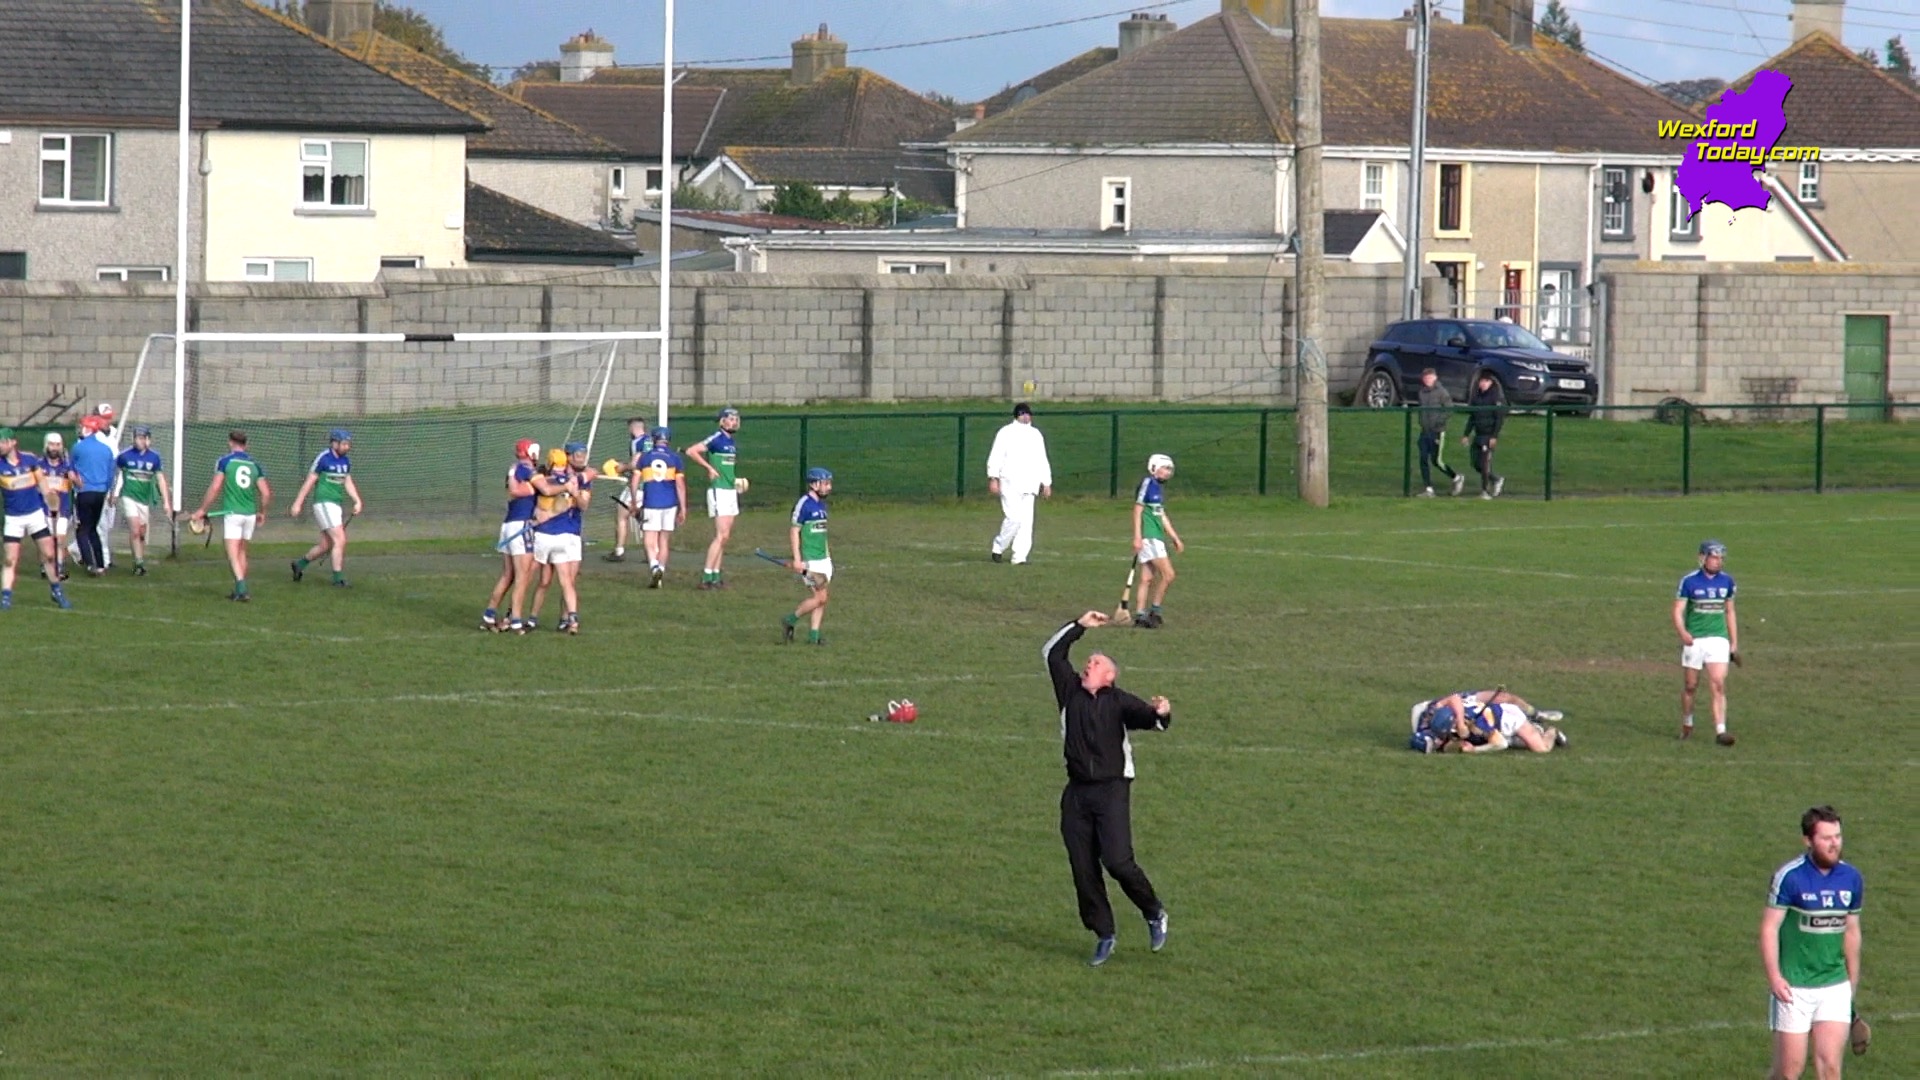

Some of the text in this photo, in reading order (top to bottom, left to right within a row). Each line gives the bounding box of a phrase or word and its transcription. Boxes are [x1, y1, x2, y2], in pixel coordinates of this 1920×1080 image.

[235, 465, 251, 488] 6
[651, 459, 667, 482] 9
[1822, 895, 1834, 908] 14
